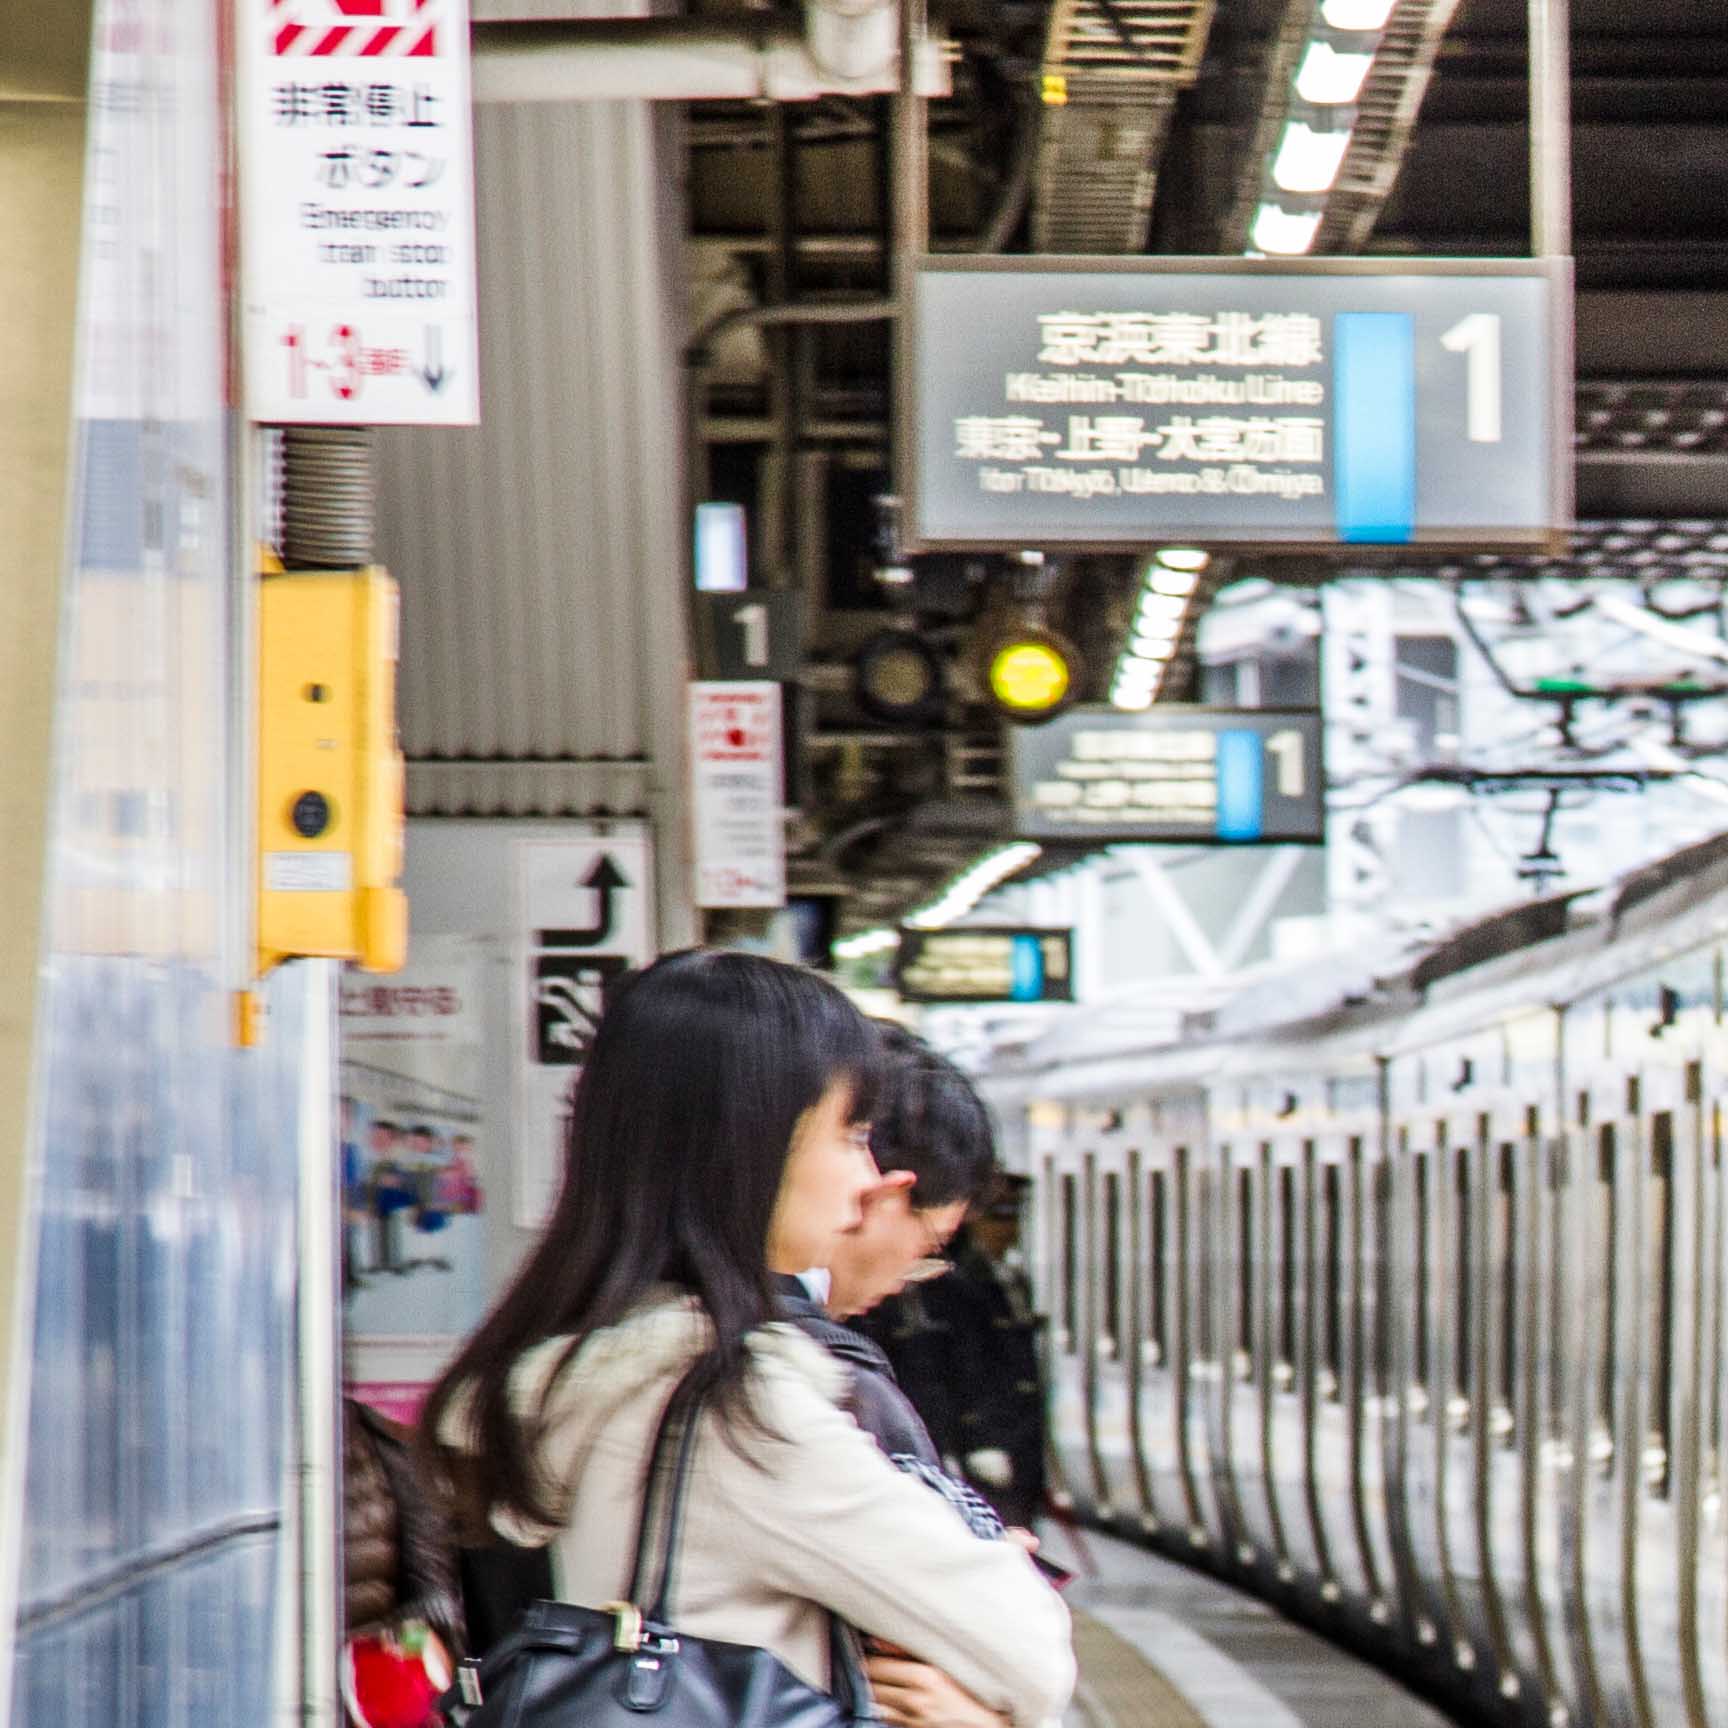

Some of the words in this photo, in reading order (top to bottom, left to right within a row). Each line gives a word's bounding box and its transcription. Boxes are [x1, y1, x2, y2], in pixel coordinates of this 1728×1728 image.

[273, 83, 440, 127] 非常停止
[320, 144, 446, 187] ボタン
[300, 202, 448, 230] Emergency
[1037, 312, 1323, 366] 京浜東北線
[1244, 373, 1324, 404] Line
[1440, 313, 1501, 442] 1
[733, 605, 767, 667] 1
[1266, 730, 1303, 796] 1
